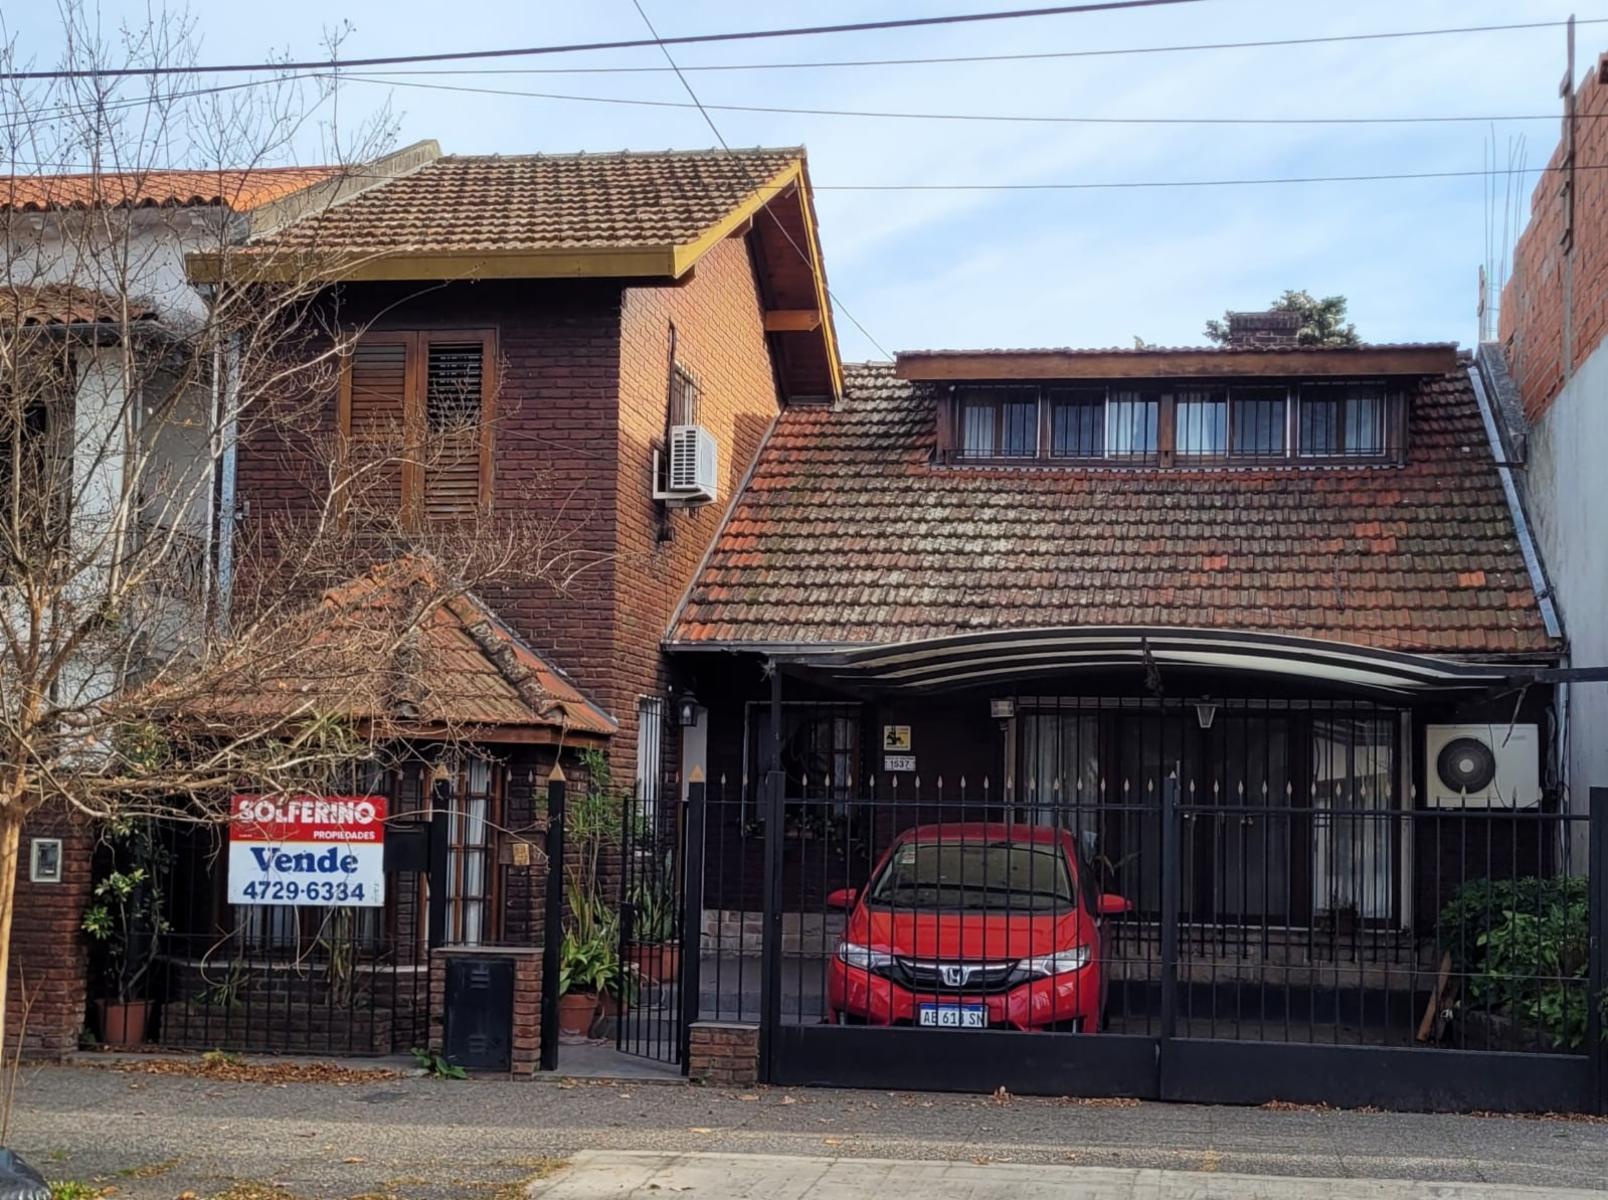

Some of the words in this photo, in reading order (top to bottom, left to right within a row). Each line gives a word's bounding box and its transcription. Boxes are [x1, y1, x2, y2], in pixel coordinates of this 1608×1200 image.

[239, 800, 376, 825] SOLFERINO
[313, 830, 376, 840] PROPIEDADES
[250, 846, 359, 873] Vende
